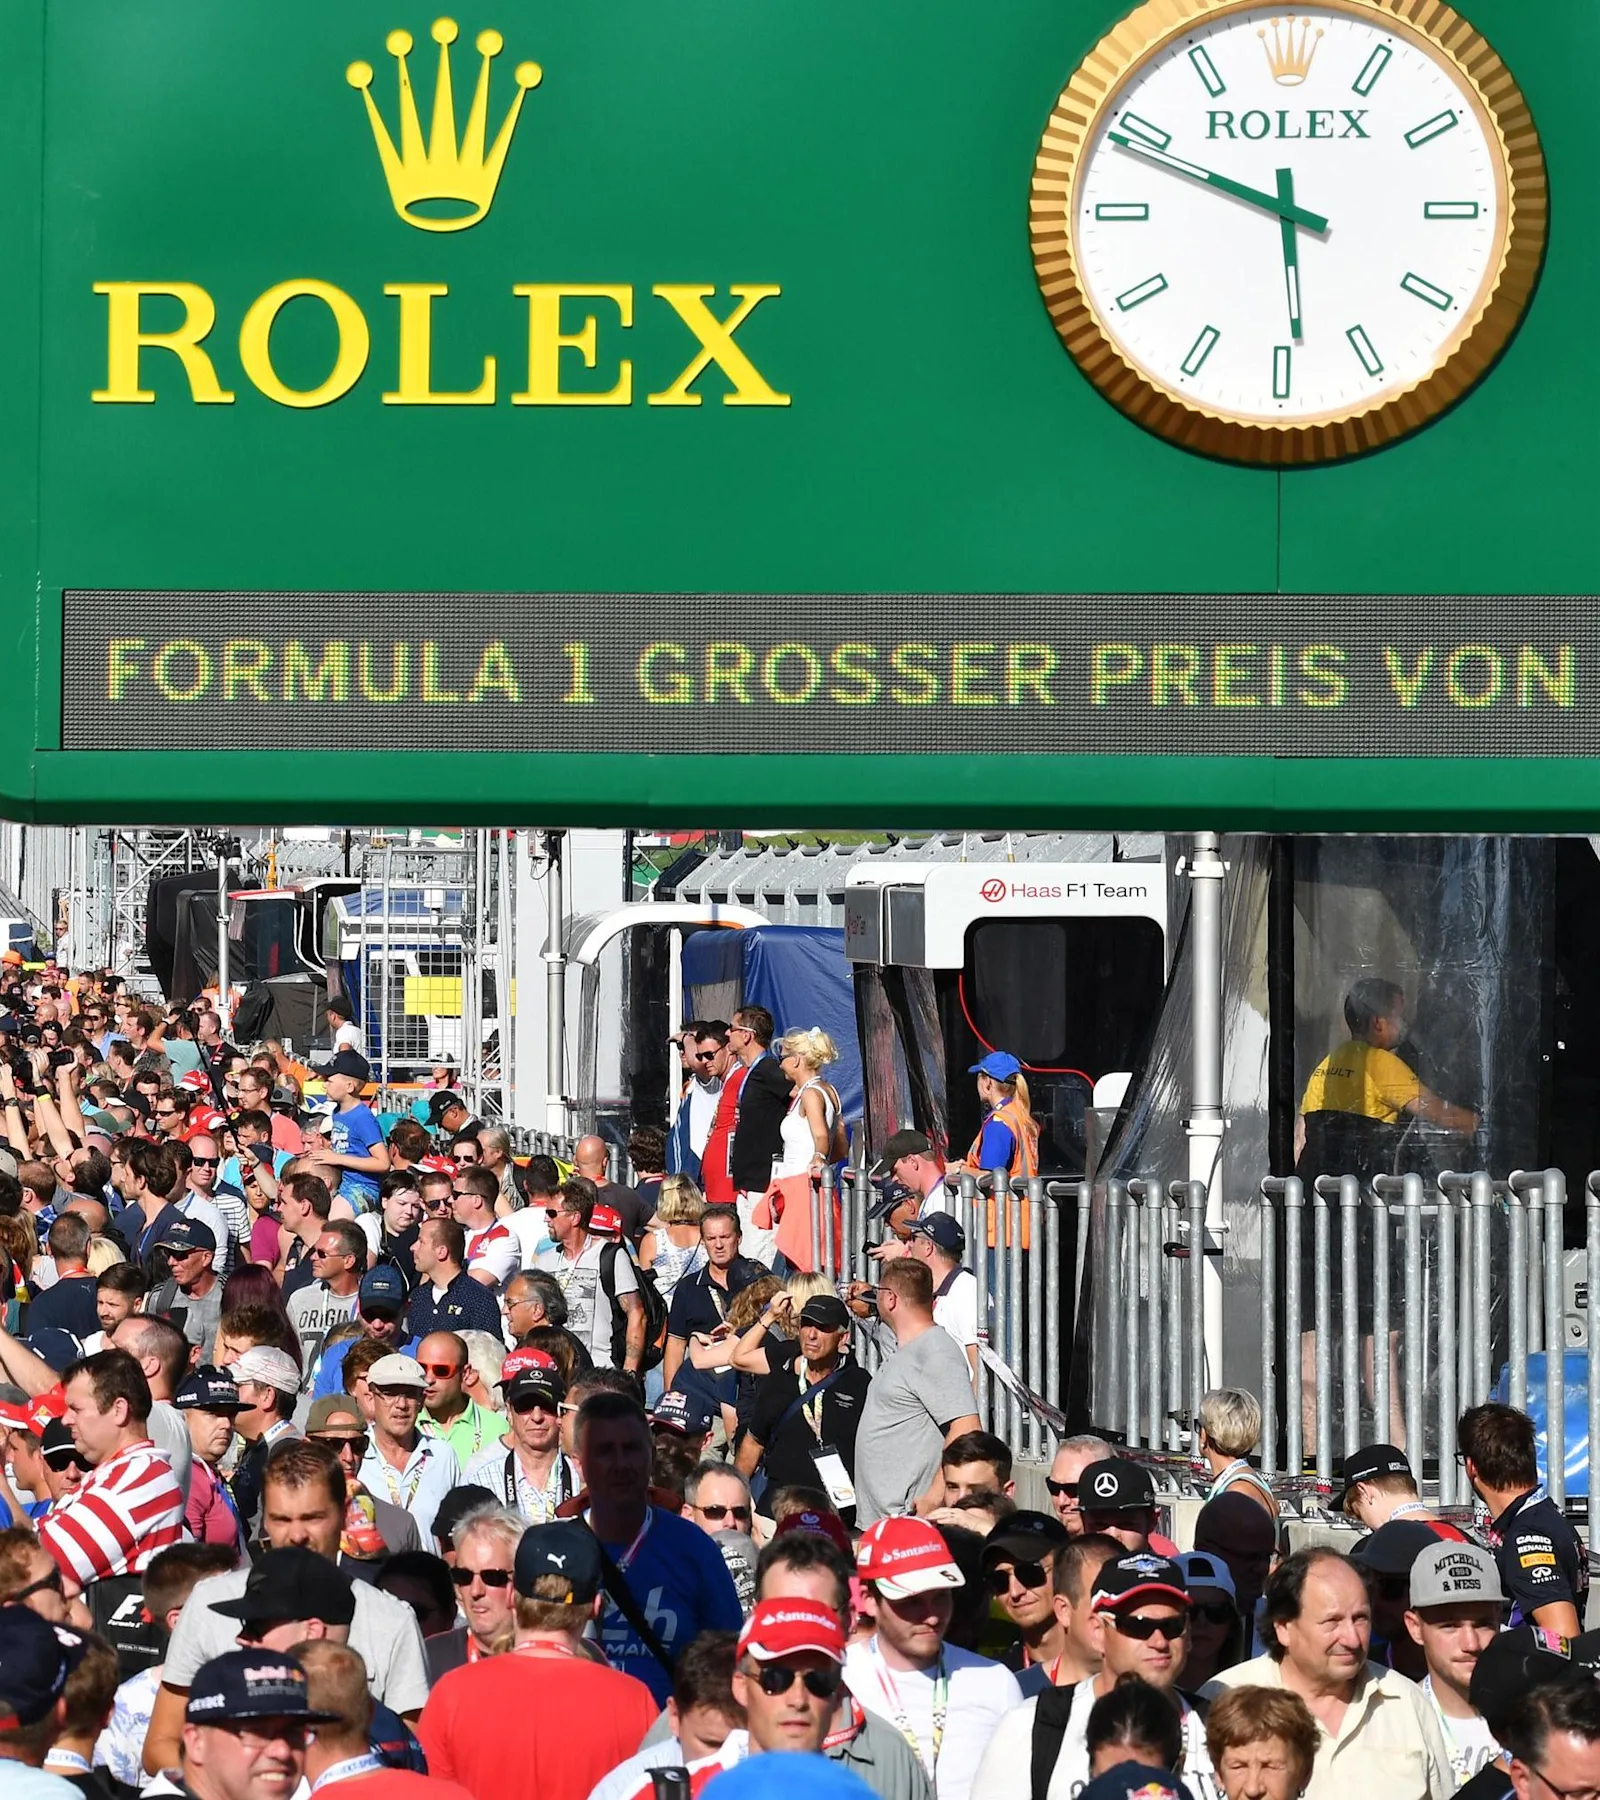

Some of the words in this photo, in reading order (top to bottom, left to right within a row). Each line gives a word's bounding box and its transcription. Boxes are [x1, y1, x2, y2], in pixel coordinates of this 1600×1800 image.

[1205, 110, 1370, 139] ROLEX
[91, 278, 791, 409] ROLEX
[107, 639, 523, 704] FORMULA
[561, 641, 595, 704] 1
[636, 640, 1060, 707] GROSSER
[1090, 643, 1351, 708] PREIS
[1383, 643, 1576, 708] VON
[1011, 883, 1062, 898] Haas
[1067, 883, 1088, 898] F1
[1093, 883, 1147, 898] Team
[506, 1474, 515, 1502] SONY
[1516, 1535, 1552, 1545] CASIO
[1517, 1544, 1553, 1554] RENAULT
[892, 1541, 942, 1560] Santander
[1434, 1553, 1484, 1576] MITCHELL
[1442, 1582, 1451, 1592] &
[1454, 1579, 1482, 1591] NESS
[775, 1611, 837, 1631] Santander
